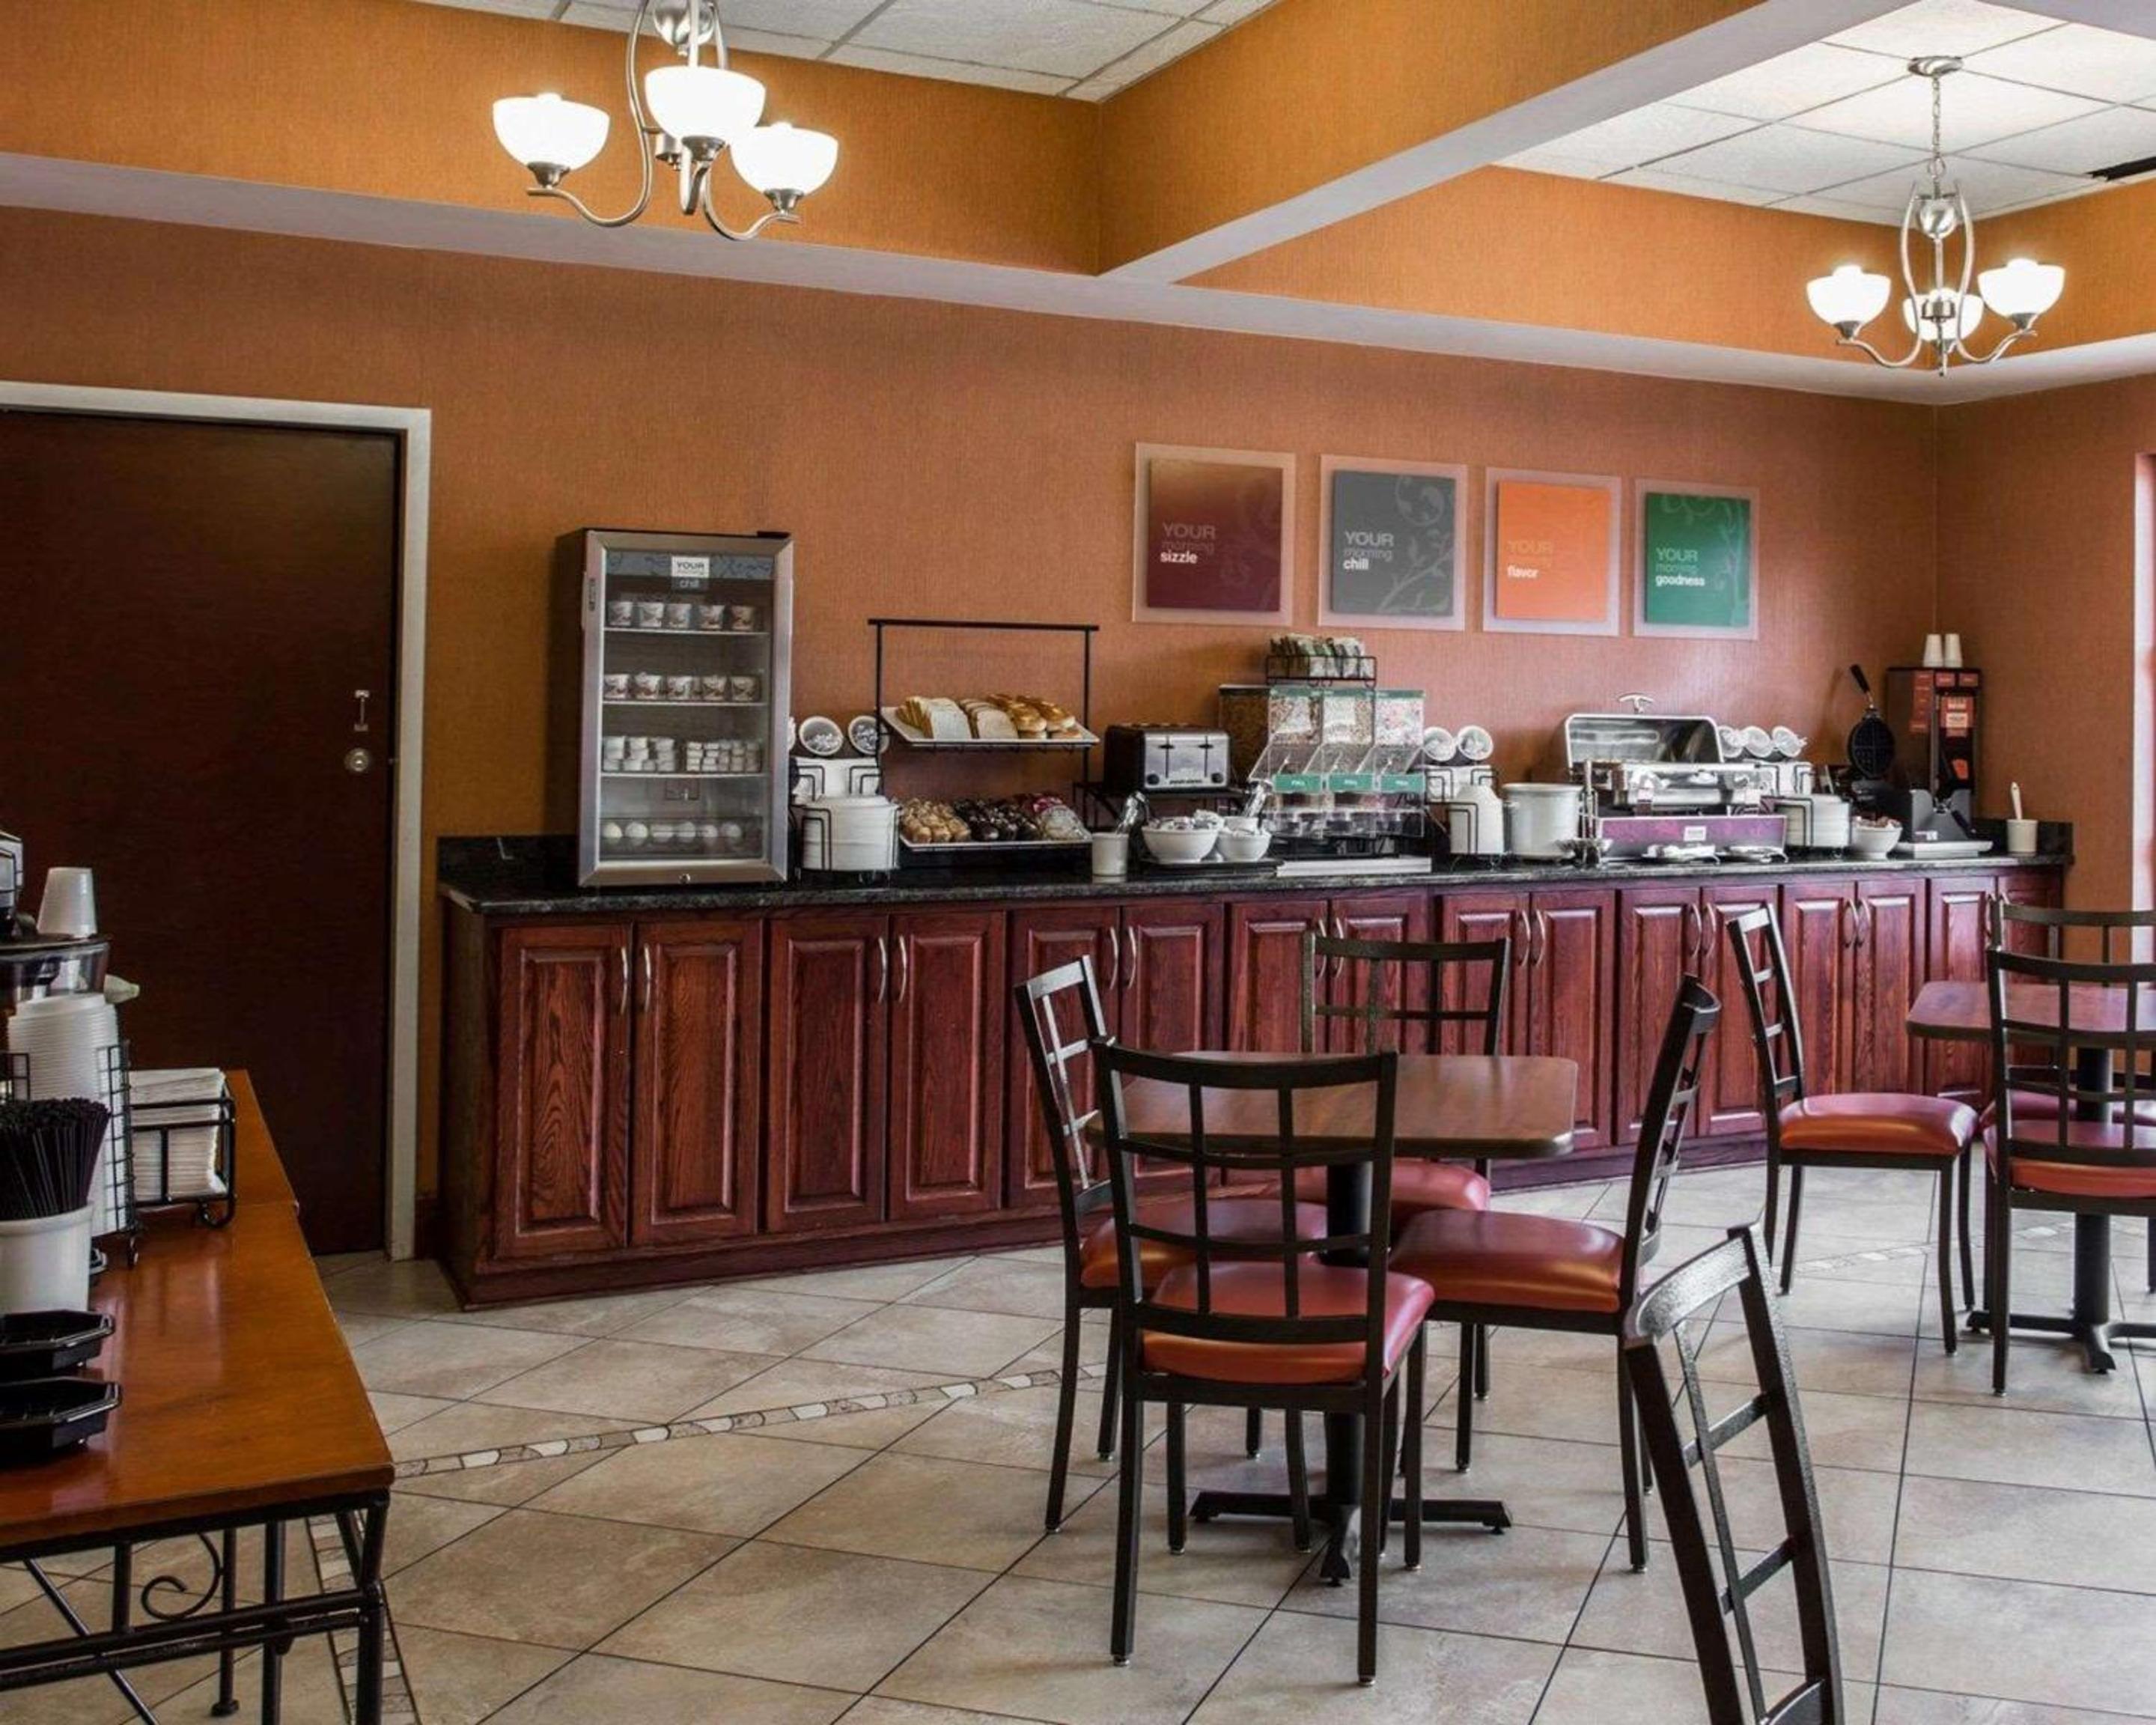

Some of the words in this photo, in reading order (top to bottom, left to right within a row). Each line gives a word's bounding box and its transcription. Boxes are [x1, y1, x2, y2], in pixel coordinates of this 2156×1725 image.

[1163, 522, 1216, 539] YOUR
[1345, 531, 1394, 547] YOUR
[1160, 550, 1198, 565] sizzle
[1656, 547, 1698, 562] YOUR
[1344, 557, 1369, 571] chill
[1507, 564, 1539, 579] flavor
[1655, 573, 1705, 586] goodness
